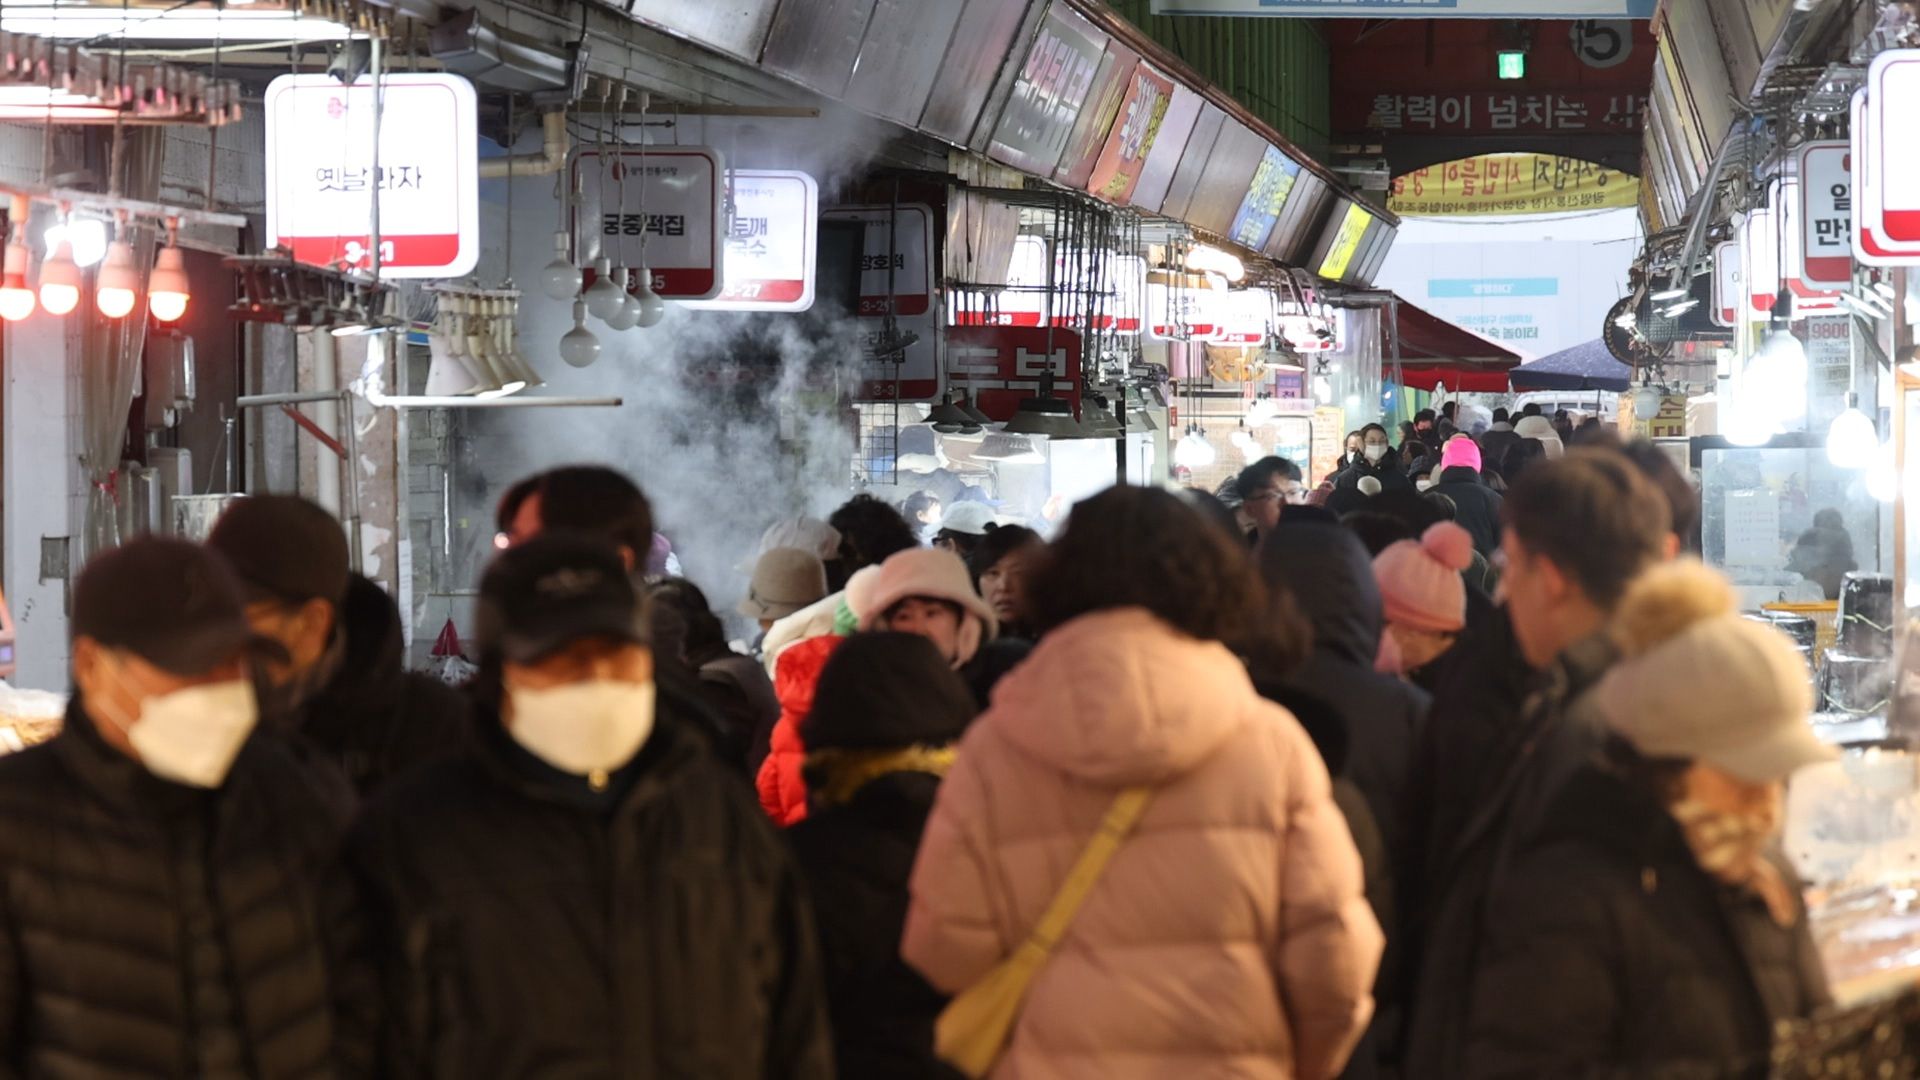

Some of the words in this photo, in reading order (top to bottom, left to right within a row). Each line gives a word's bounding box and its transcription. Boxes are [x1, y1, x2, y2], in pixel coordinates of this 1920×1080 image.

[1373, 94, 1471, 129] 활력이
[1487, 94, 1588, 130] 넘치는
[1602, 94, 1648, 129] 시
